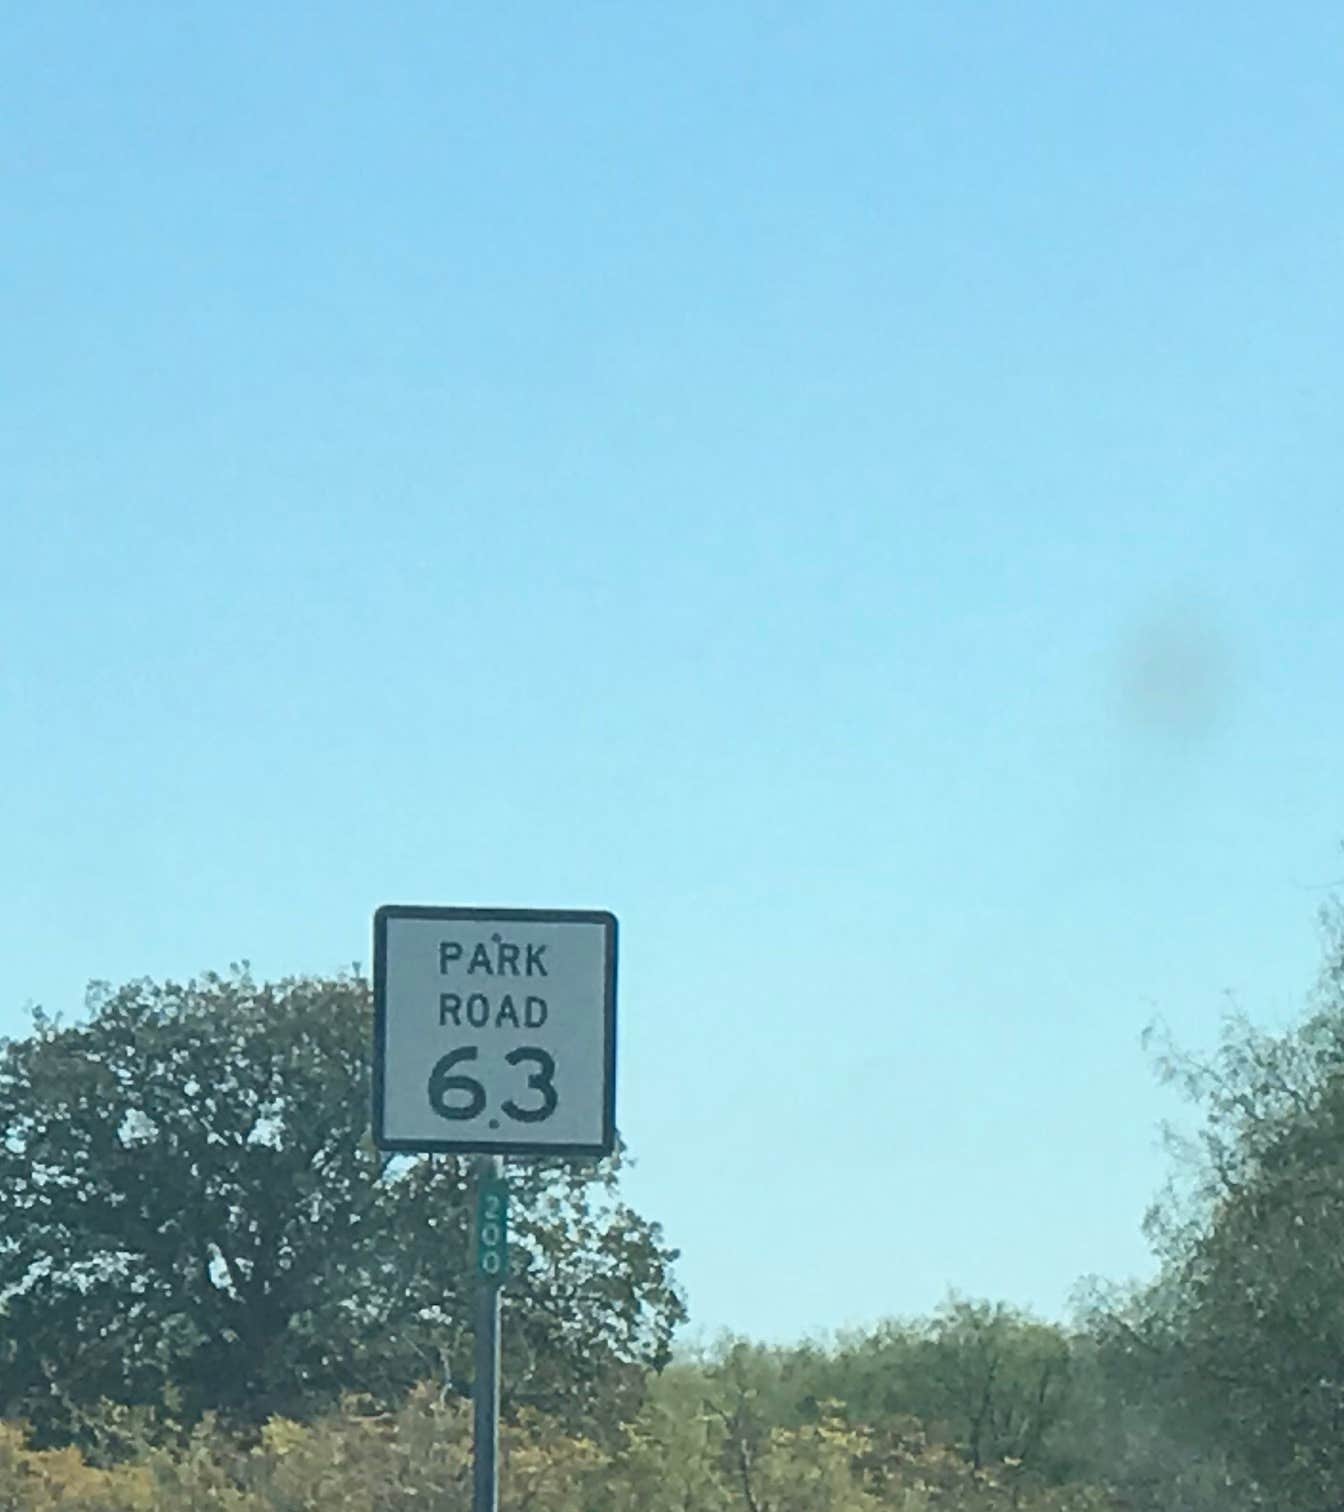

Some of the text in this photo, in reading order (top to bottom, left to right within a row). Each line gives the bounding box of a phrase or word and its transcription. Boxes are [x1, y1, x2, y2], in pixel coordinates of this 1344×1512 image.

[439, 941, 549, 977] PARK
[438, 993, 548, 1029] ROAD
[427, 1045, 559, 1123] 63
